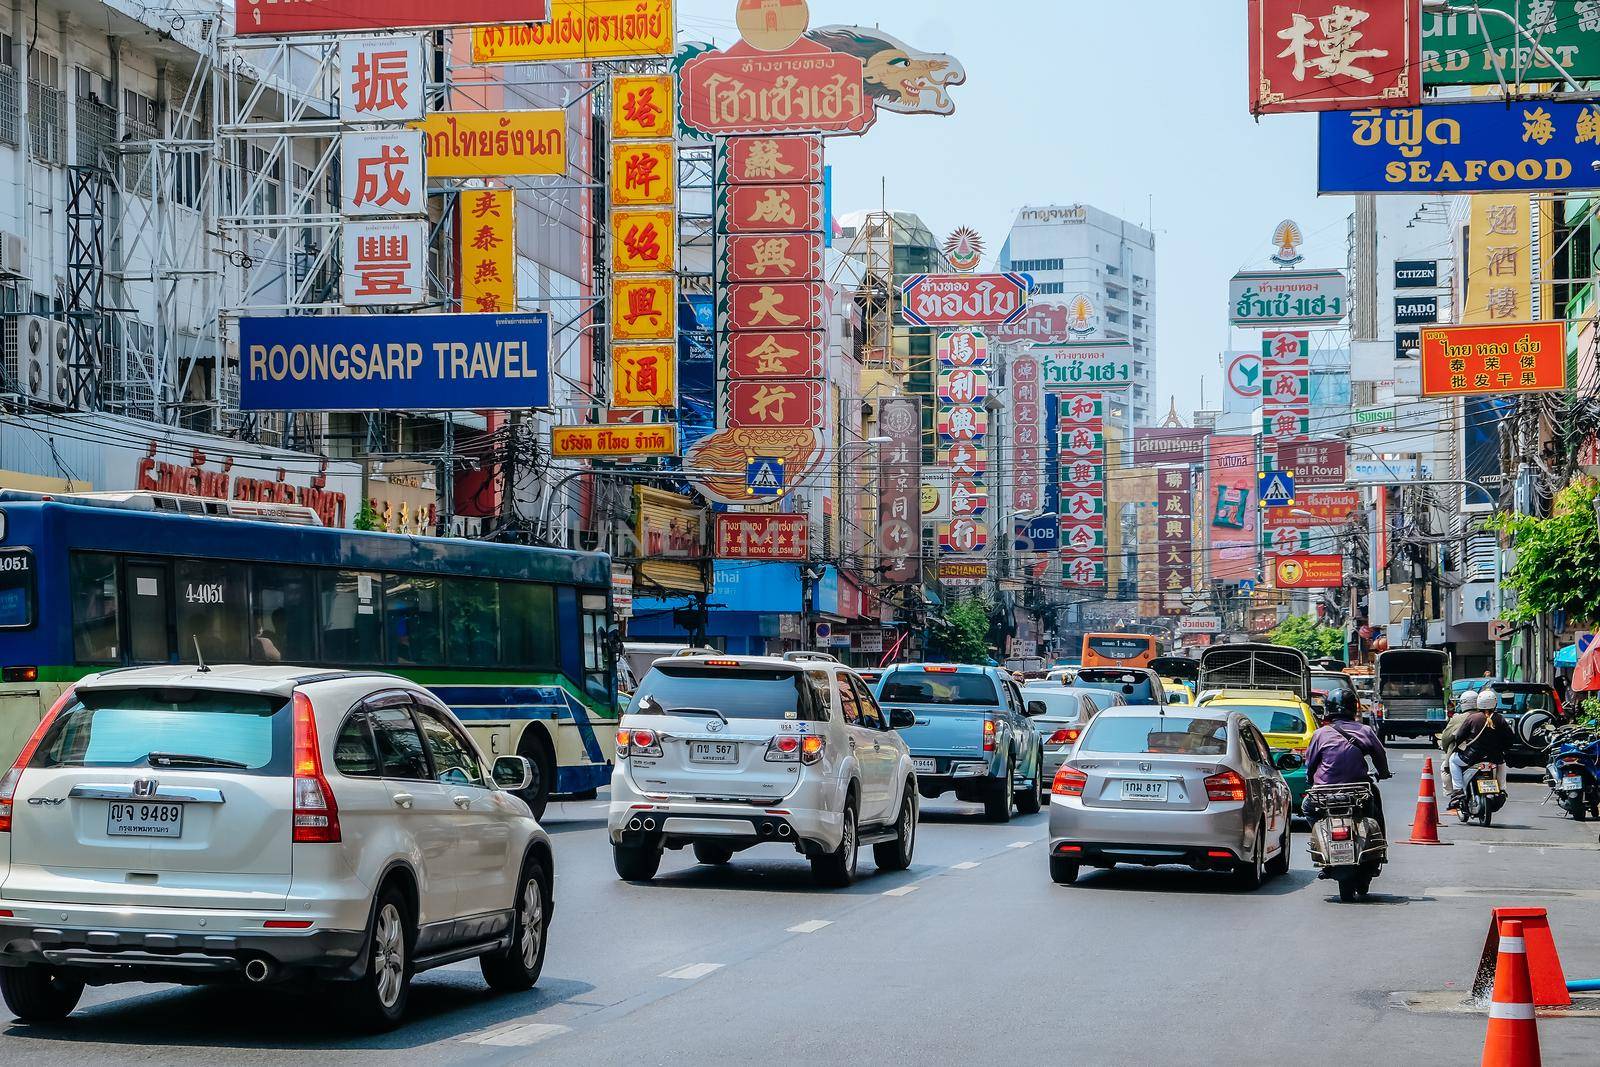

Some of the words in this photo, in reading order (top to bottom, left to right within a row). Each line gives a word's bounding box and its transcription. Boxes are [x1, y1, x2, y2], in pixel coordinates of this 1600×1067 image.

[1483, 46, 1579, 71] NEST
[1385, 158, 1572, 183] SEAFOOD
[1397, 269, 1435, 279] CITIZEN
[1397, 304, 1436, 313] RADO
[250, 343, 423, 381] ROONGSARP
[433, 341, 538, 379] TRAVEL
[1312, 465, 1343, 476] Royal
[1479, 474, 1501, 484] CITIZE
[1028, 528, 1055, 539] UOB
[768, 547, 803, 555] GOLDSMITH
[939, 564, 987, 575] EXCHANGE
[185, 583, 224, 604] 4-4051
[716, 744, 733, 755] 567
[1146, 783, 1163, 793] 817
[140, 805, 179, 823] 9489
